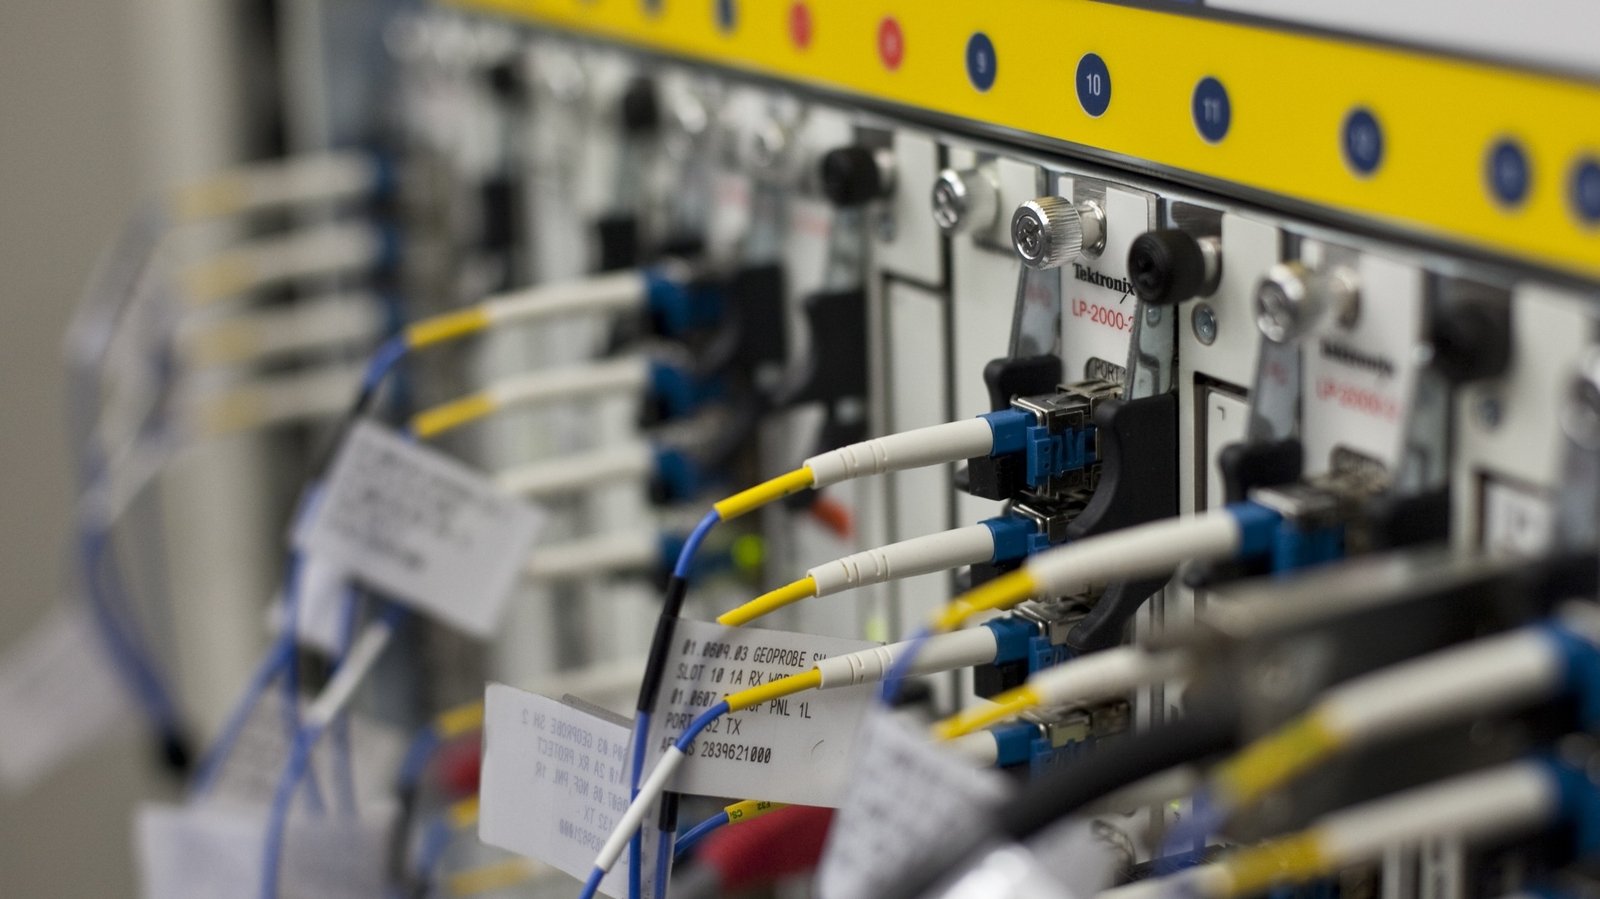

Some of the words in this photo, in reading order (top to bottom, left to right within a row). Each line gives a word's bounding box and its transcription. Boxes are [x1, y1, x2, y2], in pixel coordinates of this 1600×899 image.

[1086, 73, 1101, 96] 10
[1203, 97, 1220, 124] 11
[1073, 263, 1136, 304] Tektronix
[753, 646, 807, 668] GEOPROBE
[676, 663, 704, 681] SLOT
[711, 667, 724, 685] 10
[730, 669, 743, 685] 1A
[748, 670, 763, 686] RX
[770, 698, 790, 717] PNL
[799, 701, 812, 719] 1L
[665, 712, 695, 730] PORT
[726, 718, 742, 735] TX
[701, 742, 772, 764] 2839621000
